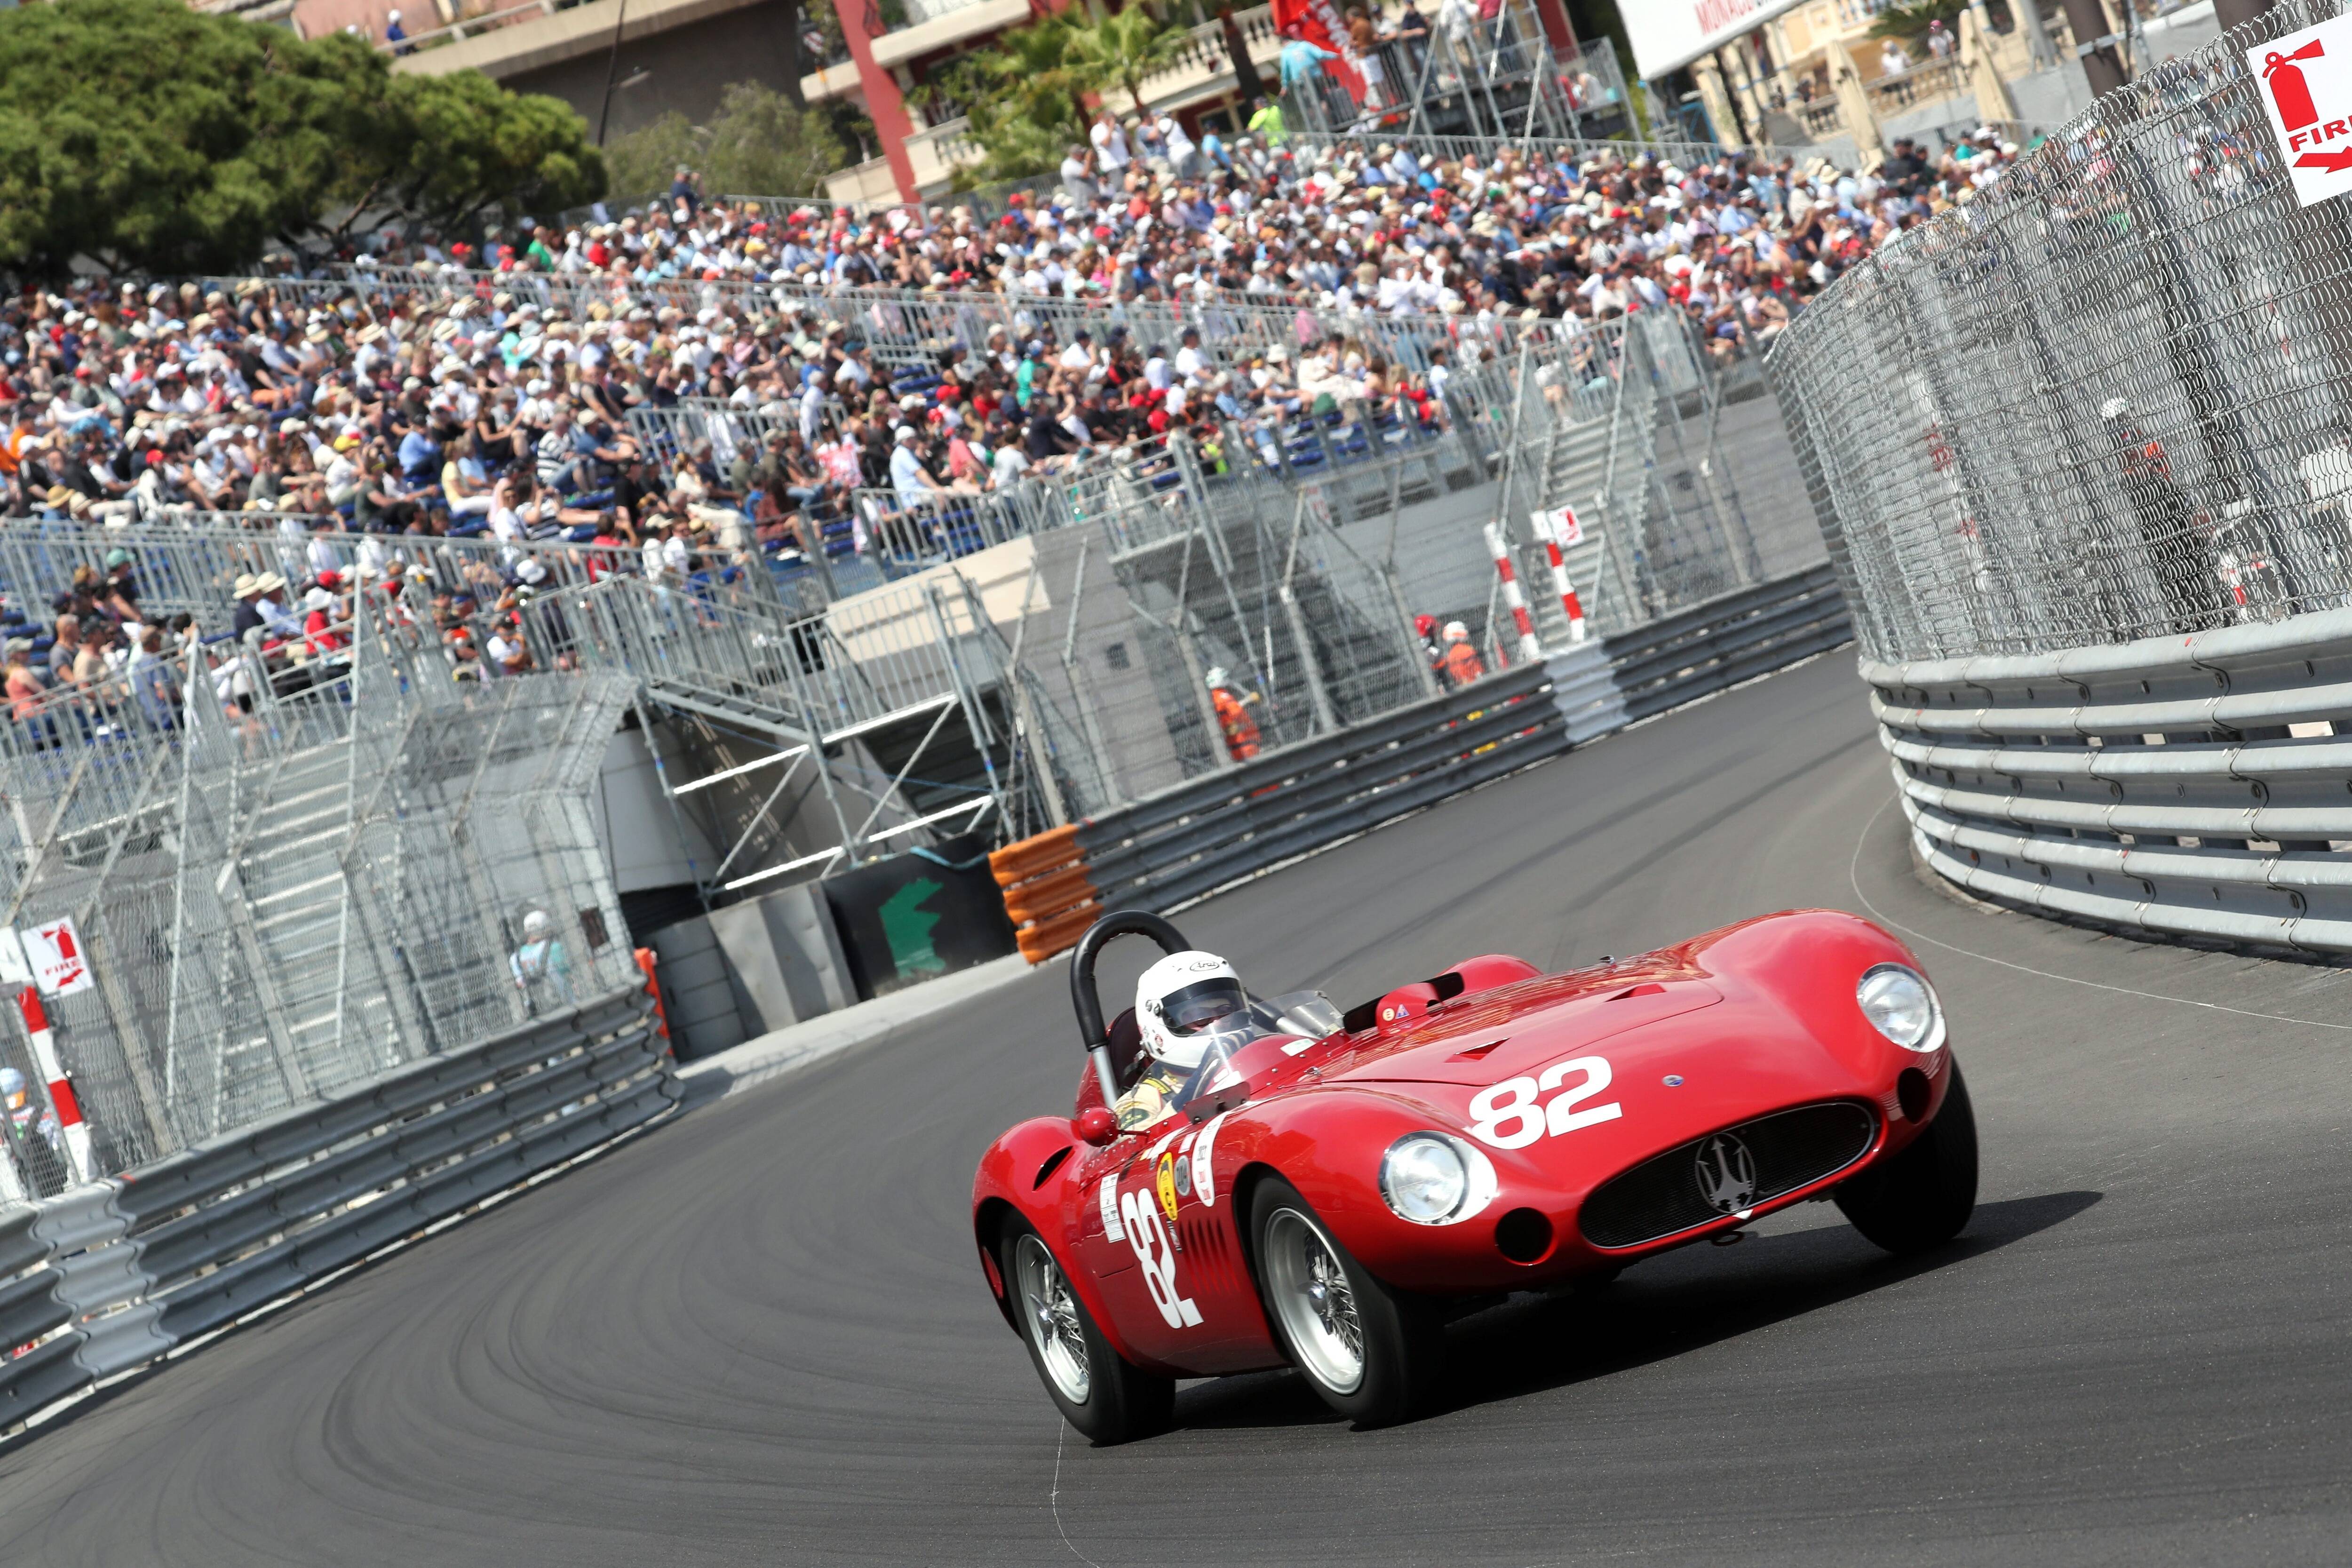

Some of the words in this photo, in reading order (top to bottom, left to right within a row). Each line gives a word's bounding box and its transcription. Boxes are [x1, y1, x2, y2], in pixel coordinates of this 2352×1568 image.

[2288, 115, 2352, 152] FIR
[45, 959, 80, 976] FIRE
[1469, 1056, 1622, 1150] 82
[1121, 1188, 1204, 1329] 82
